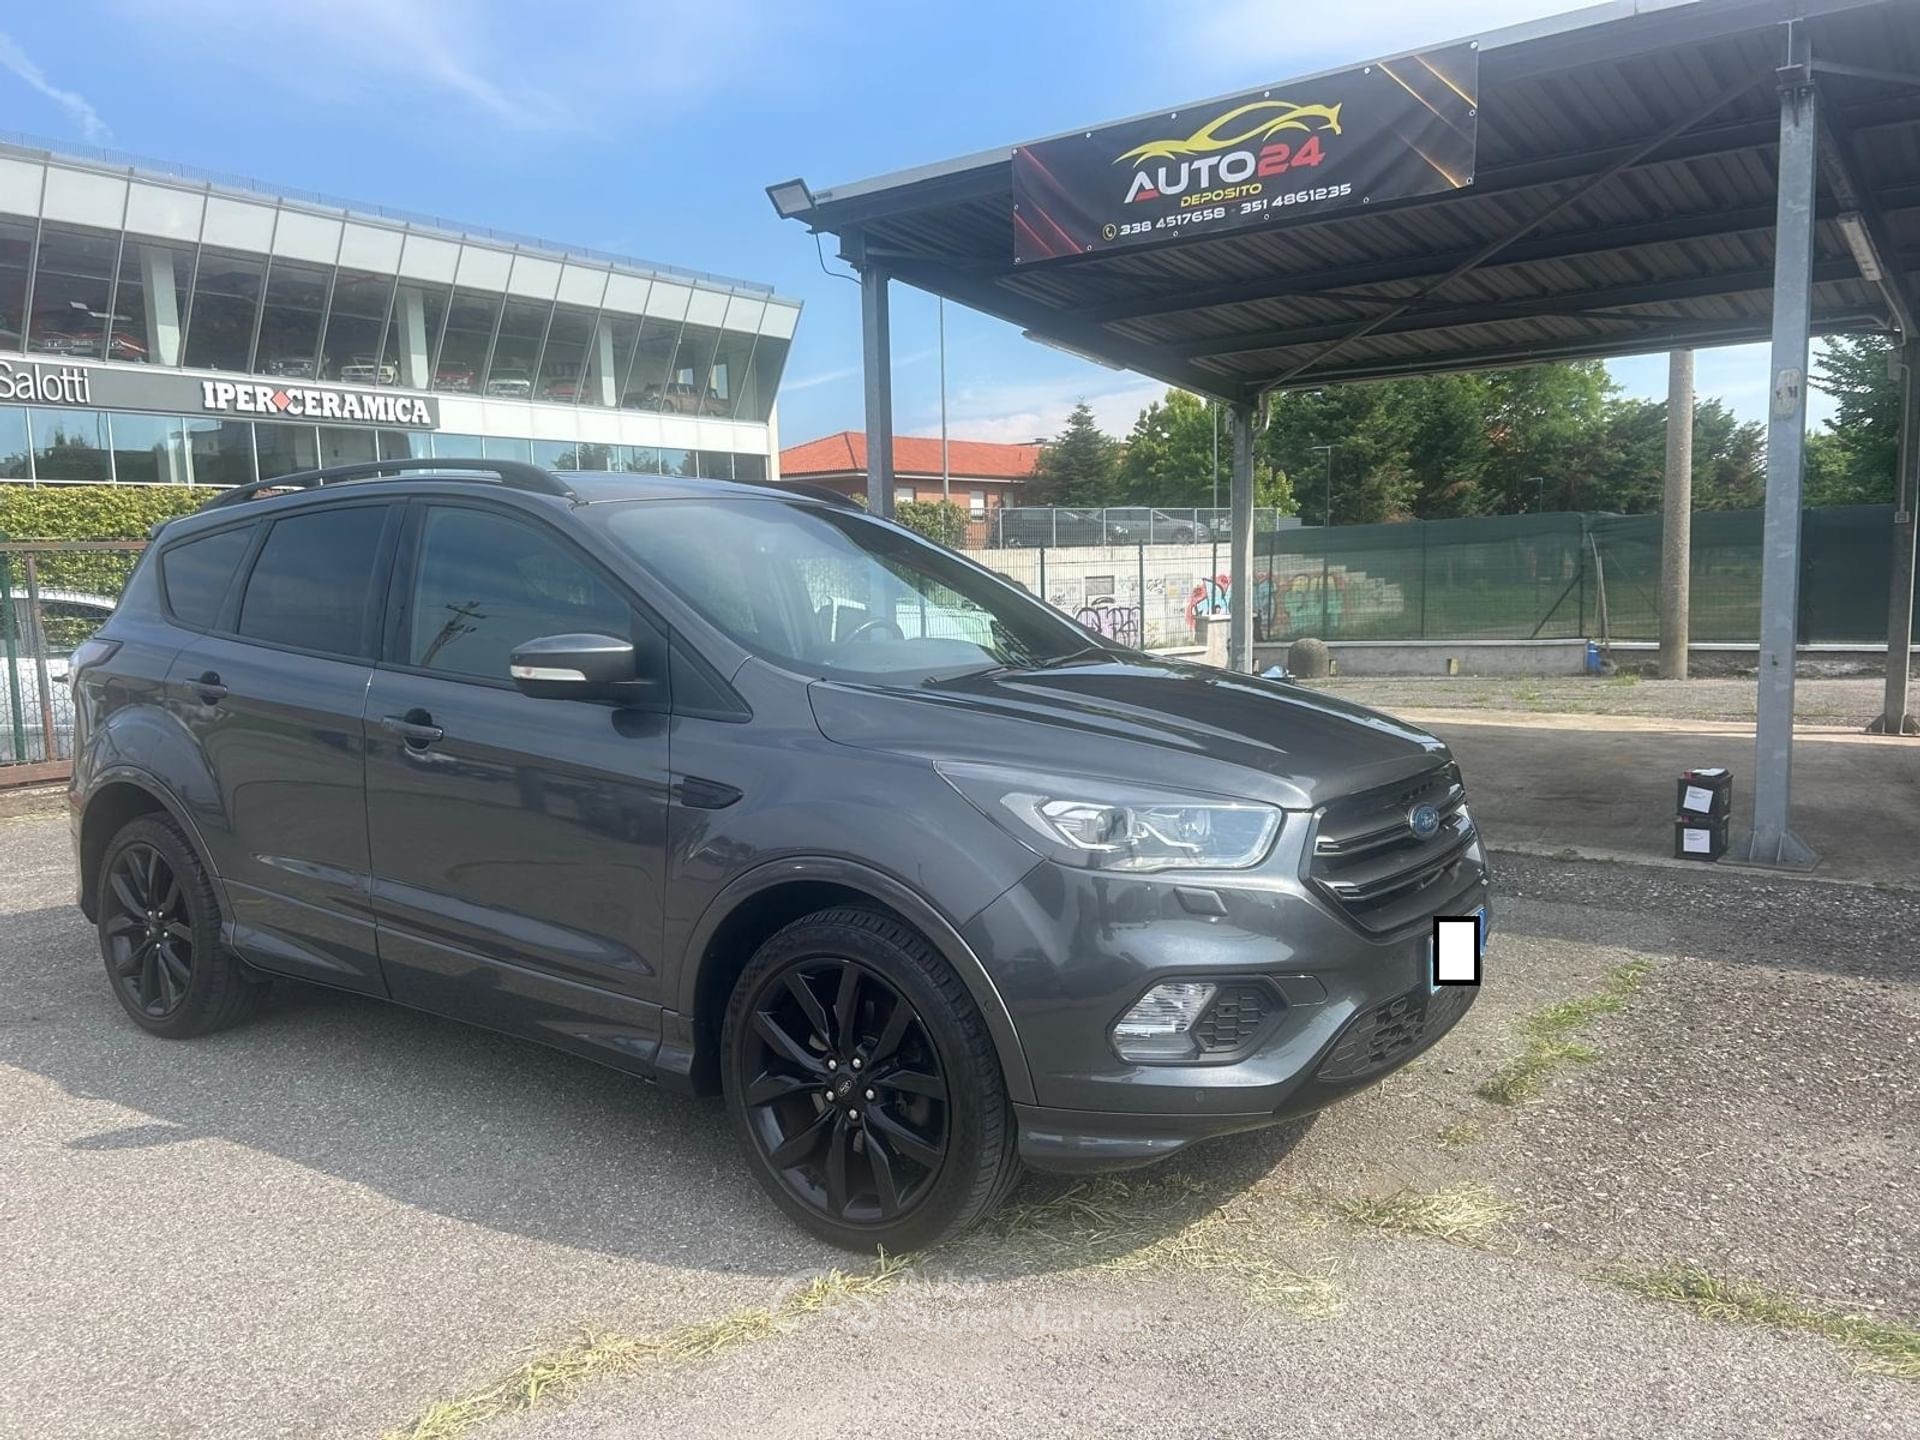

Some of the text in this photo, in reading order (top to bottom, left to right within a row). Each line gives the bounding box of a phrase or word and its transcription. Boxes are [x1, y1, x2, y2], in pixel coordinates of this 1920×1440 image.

[1124, 135, 1326, 204] AUTO24
[1119, 221, 1153, 236] 338
[1155, 207, 1226, 230] 4517658
[1240, 199, 1268, 215] 351
[1272, 183, 1352, 207] 4861235
[1180, 183, 1263, 208] DEPOSITO
[0, 361, 92, 403] Salotti
